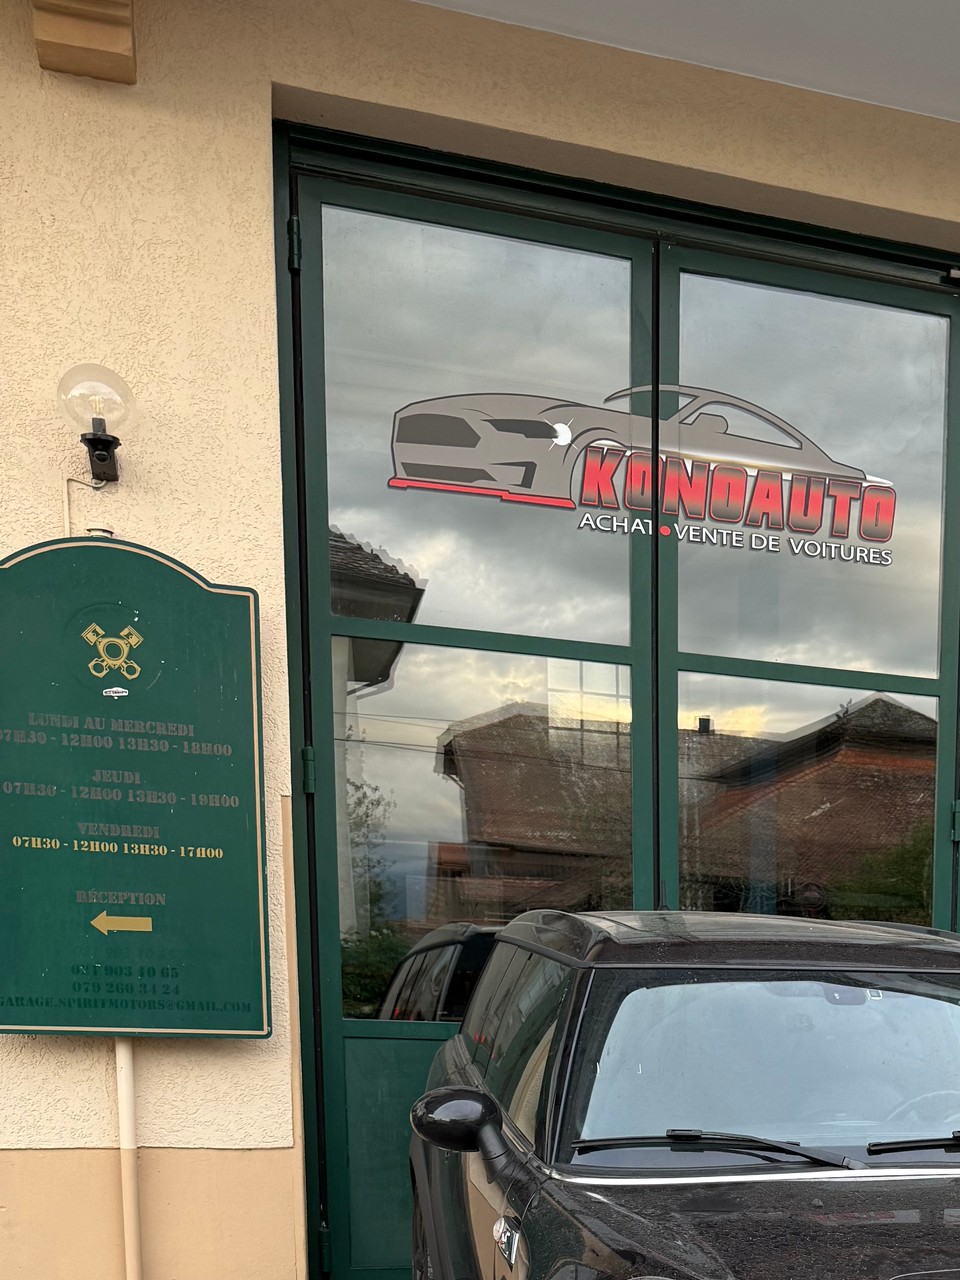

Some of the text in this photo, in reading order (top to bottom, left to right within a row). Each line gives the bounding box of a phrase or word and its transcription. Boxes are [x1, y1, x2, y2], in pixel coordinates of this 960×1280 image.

[580, 446, 896, 543] KONOAUTO
[579, 512, 893, 565] ACHAT VENTE DE VOITURES
[28, 712, 194, 737] LUNDI AU MERCREDI
[0, 729, 47, 744] 7H30
[62, 734, 113, 749] 12H00
[119, 737, 169, 752] 13H30
[183, 741, 232, 756] 18H00
[92, 769, 140, 785] JEUDI
[3, 781, 56, 797] 07H30
[72, 786, 122, 801] 12H00
[128, 790, 176, 805] 13H30
[191, 793, 239, 807] 19H00
[77, 822, 160, 838] VENDREDI
[12, 836, 60, 849] 07H30
[73, 839, 118, 853] 12H00
[123, 843, 168, 856] 13H30
[179, 846, 224, 859] 17H00
